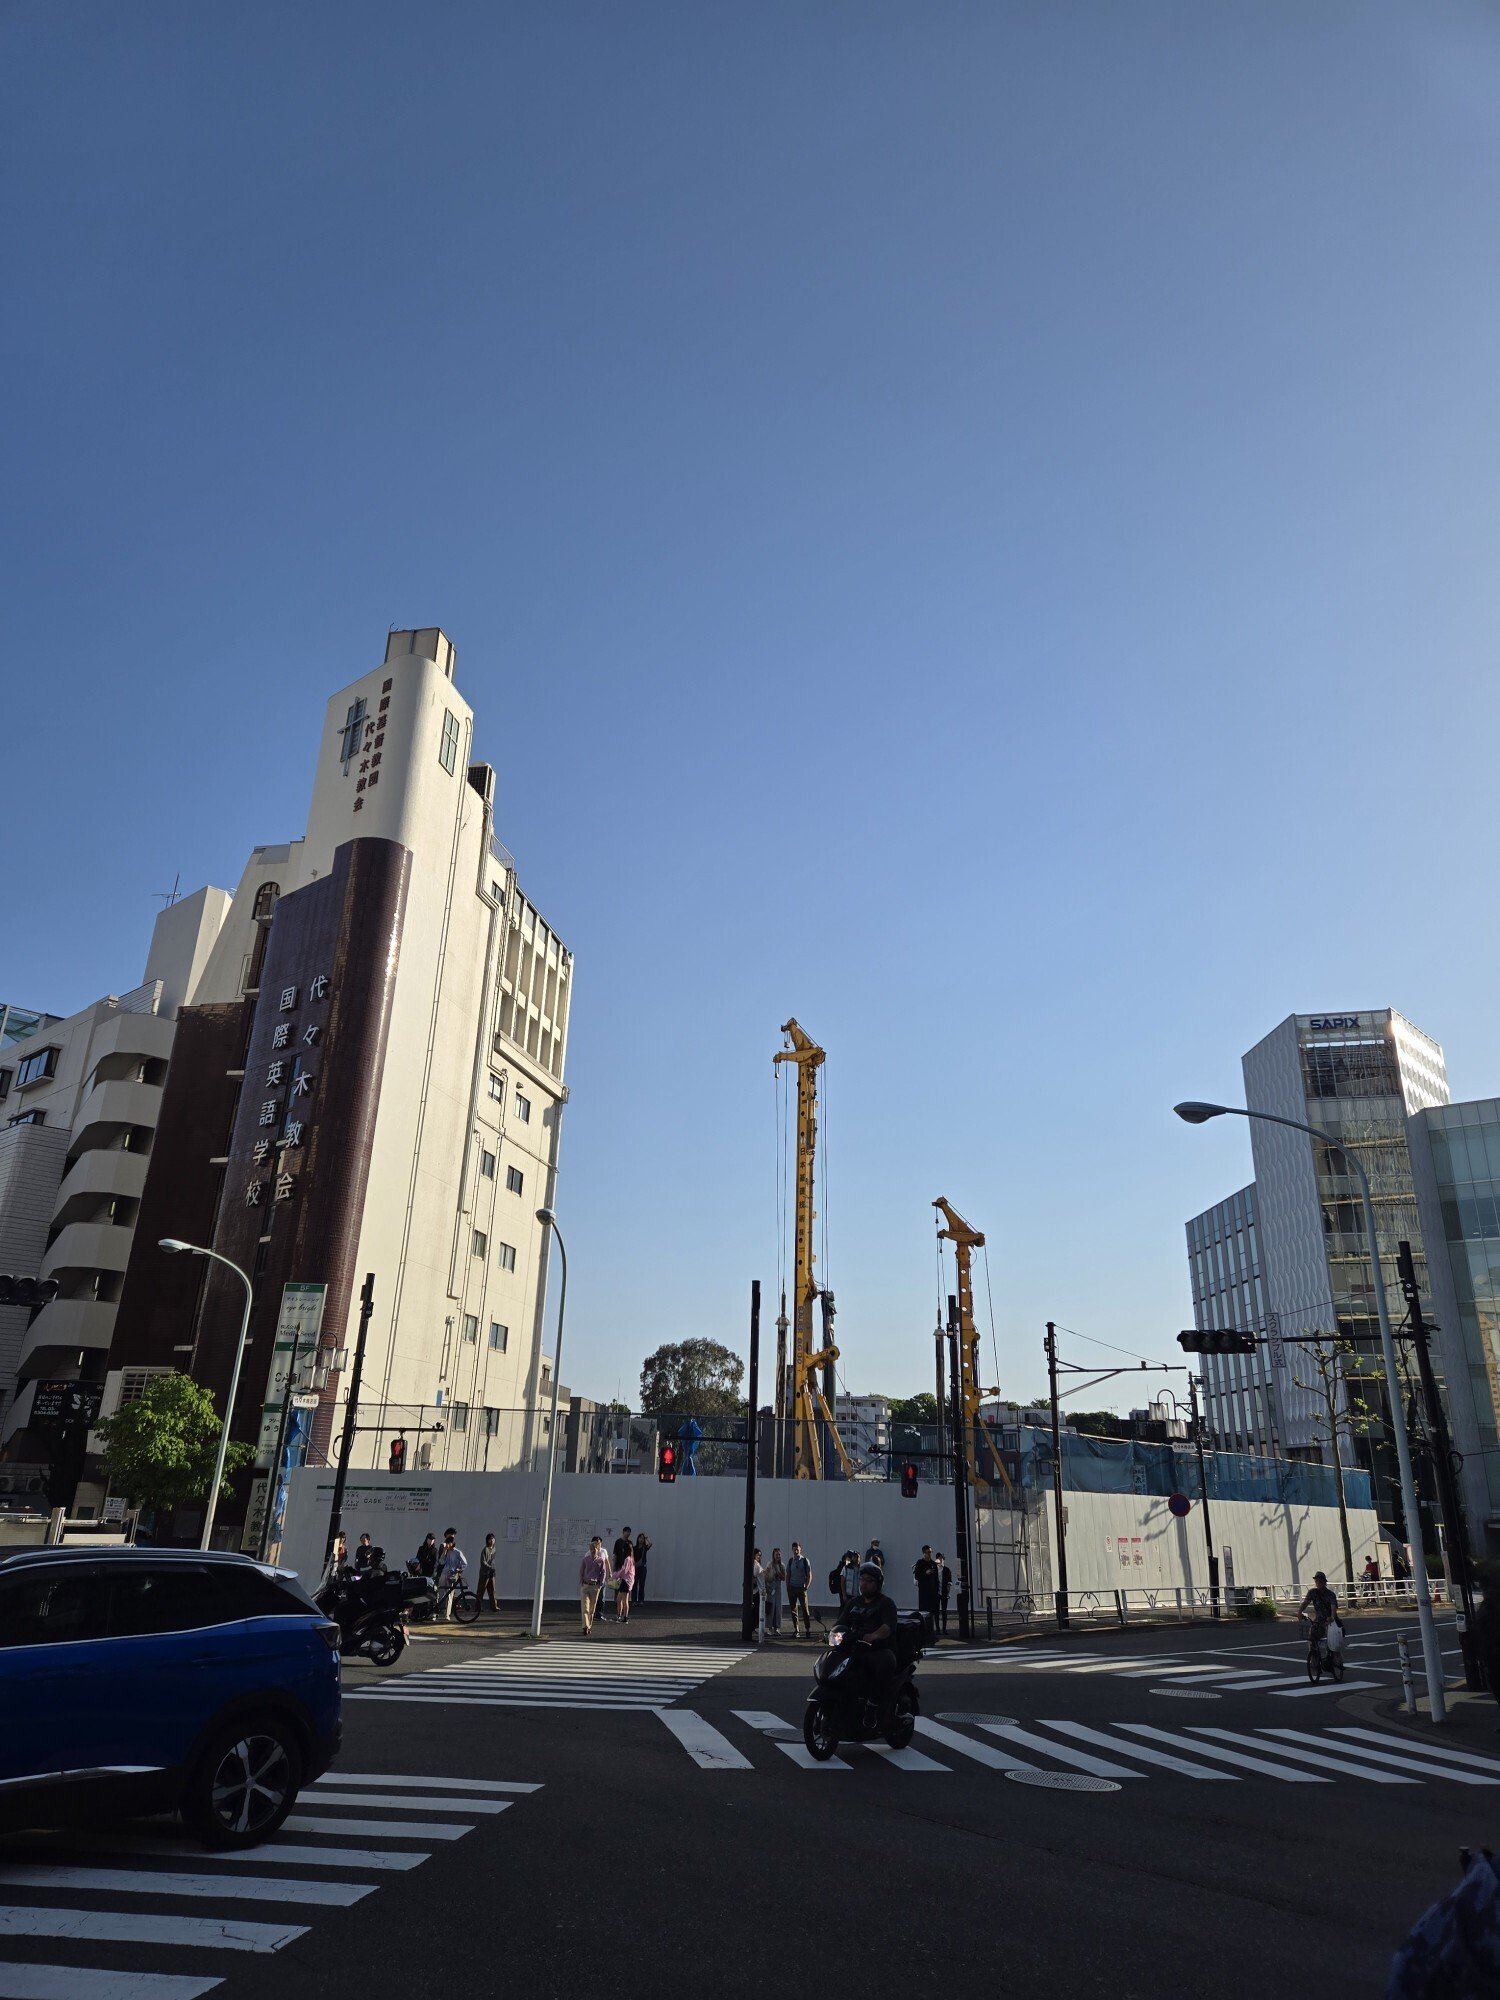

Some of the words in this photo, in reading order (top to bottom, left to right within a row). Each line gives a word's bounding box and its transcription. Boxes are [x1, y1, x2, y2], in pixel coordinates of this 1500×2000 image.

[353, 721, 375, 812] 代々木教会
[368, 678, 393, 787] 国際基督教団
[1310, 1016, 1360, 1030] SAPIX
[245, 986, 297, 1207] 国際英語学校
[275, 975, 328, 1200] 代々木教会
[247, 1482, 267, 1546] 代々木教会
